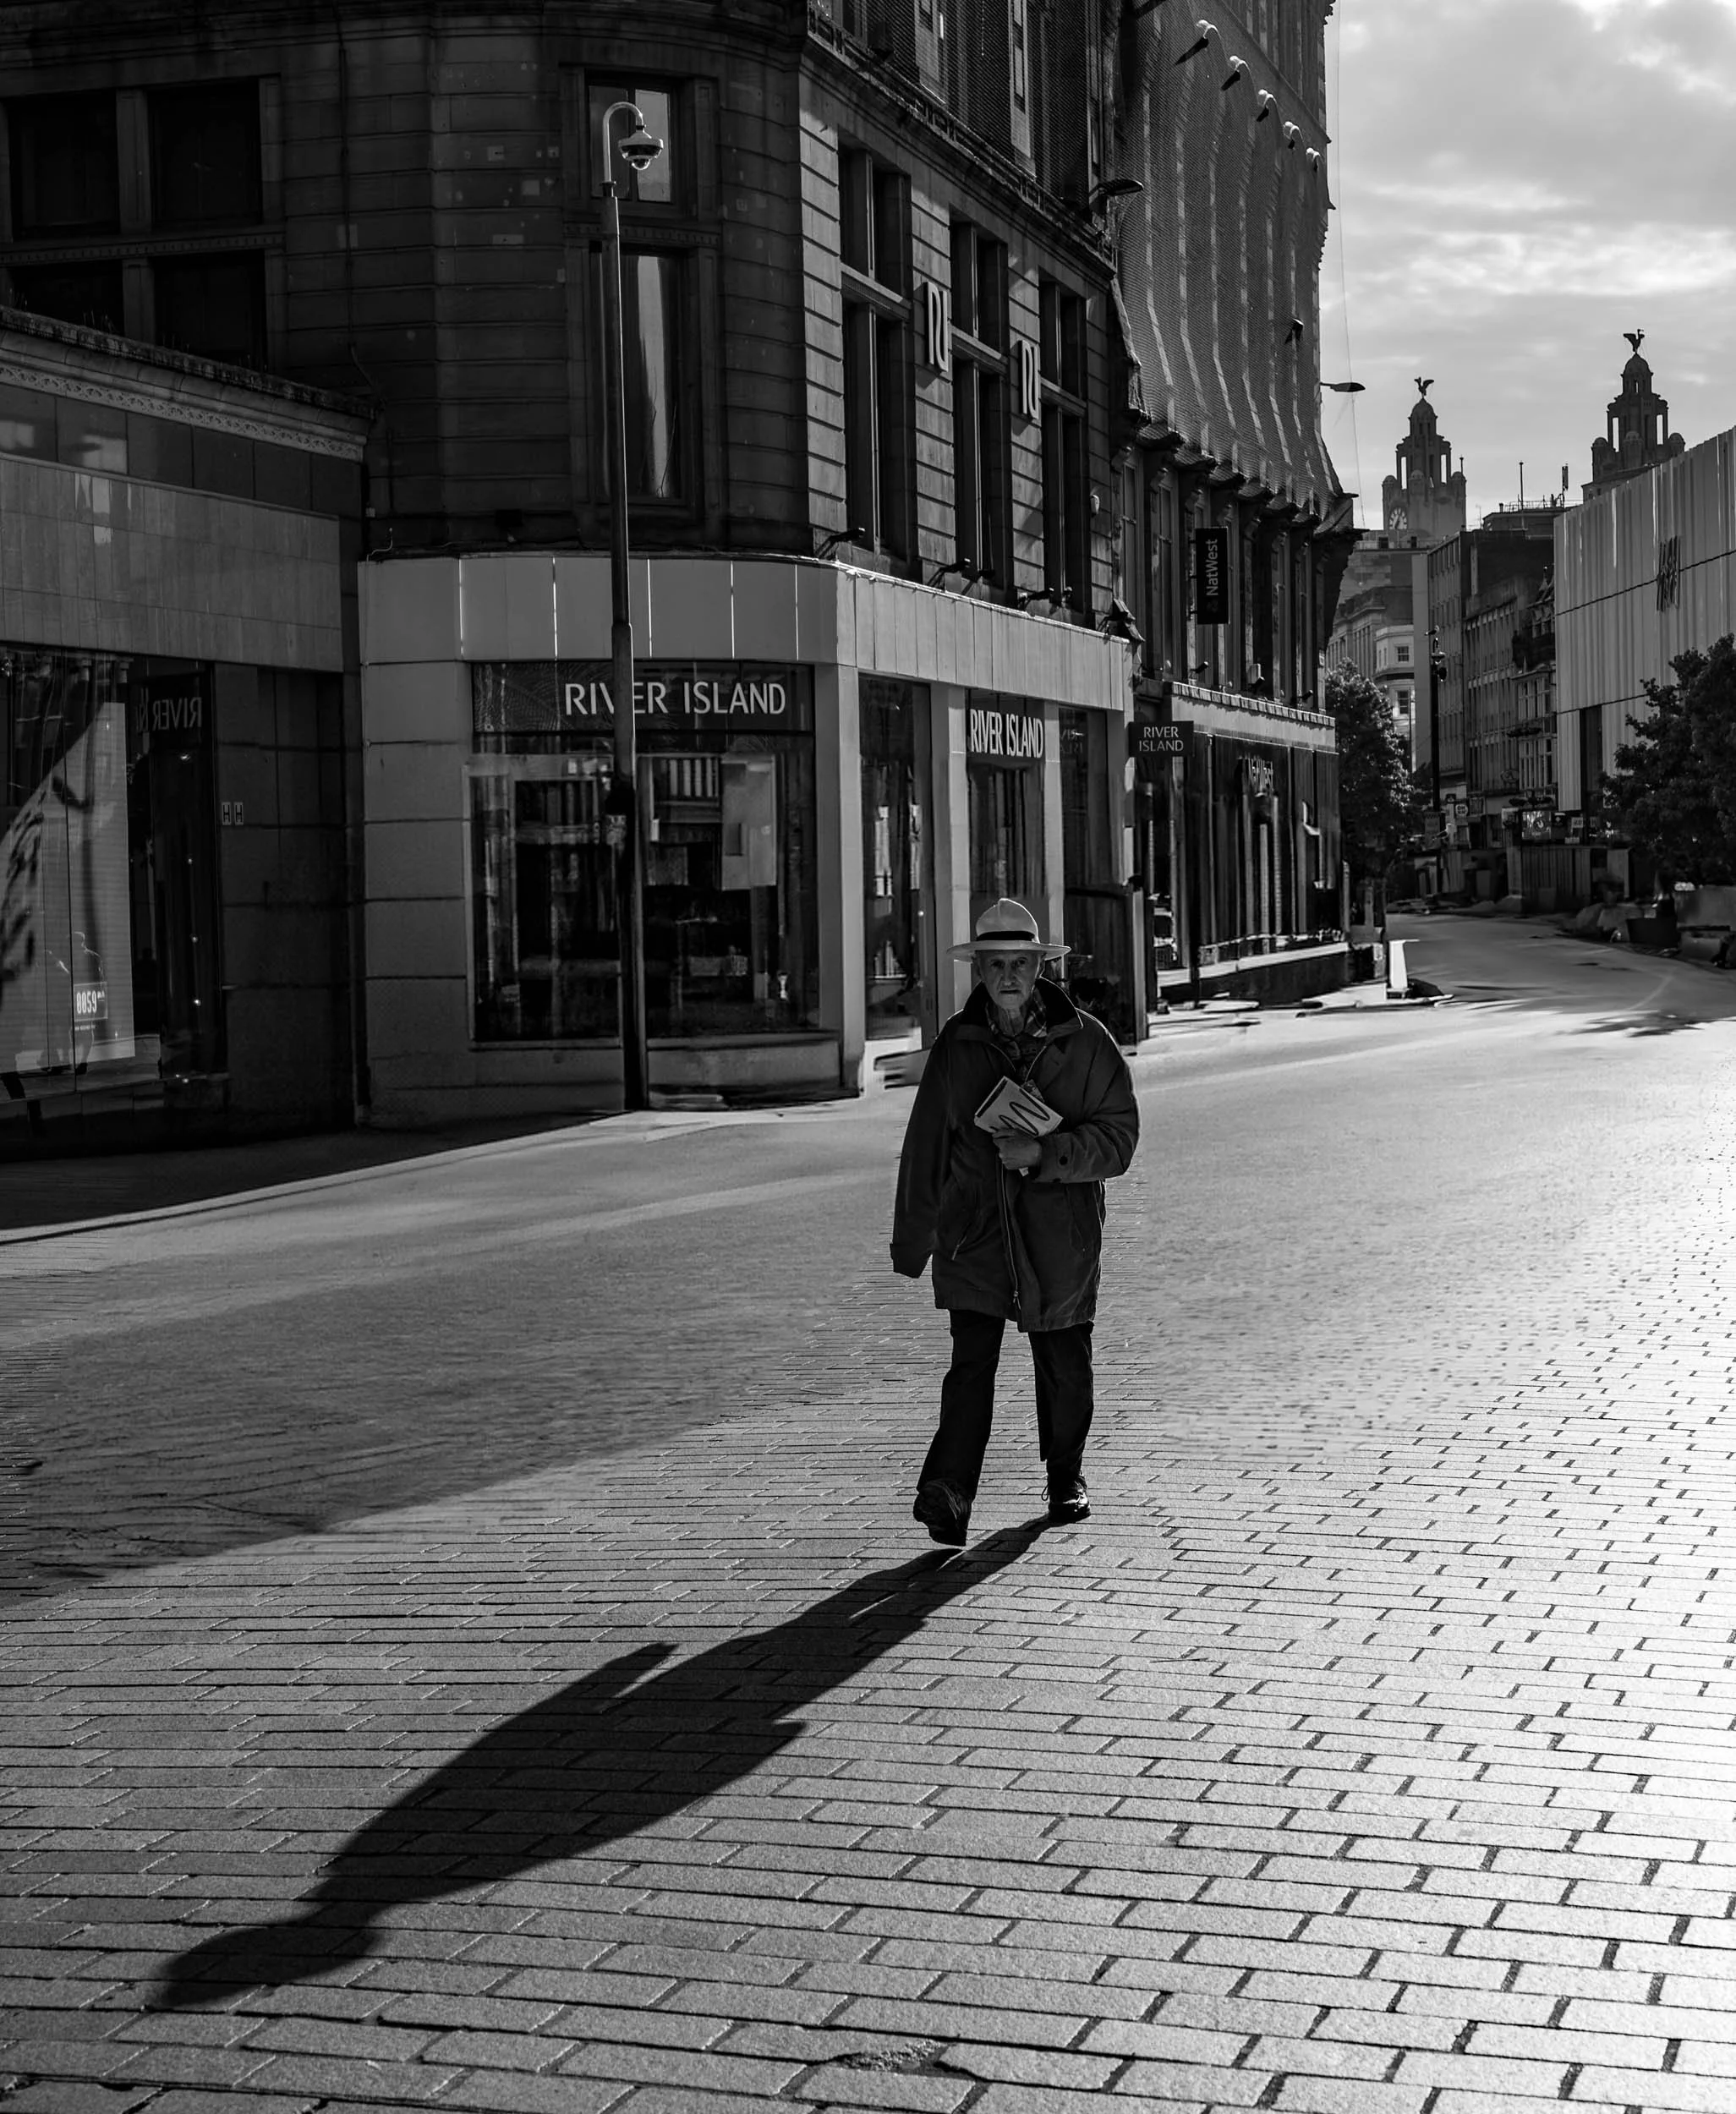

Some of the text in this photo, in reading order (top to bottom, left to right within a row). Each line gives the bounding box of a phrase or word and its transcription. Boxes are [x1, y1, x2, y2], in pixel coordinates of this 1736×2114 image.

[1205, 539, 1218, 595] NatWest
[683, 682, 786, 714] ISLAND
[969, 708, 1043, 759] RIVER ISLAND
[1138, 739, 1184, 752] ISLAND
[1143, 726, 1180, 738] RIVER
